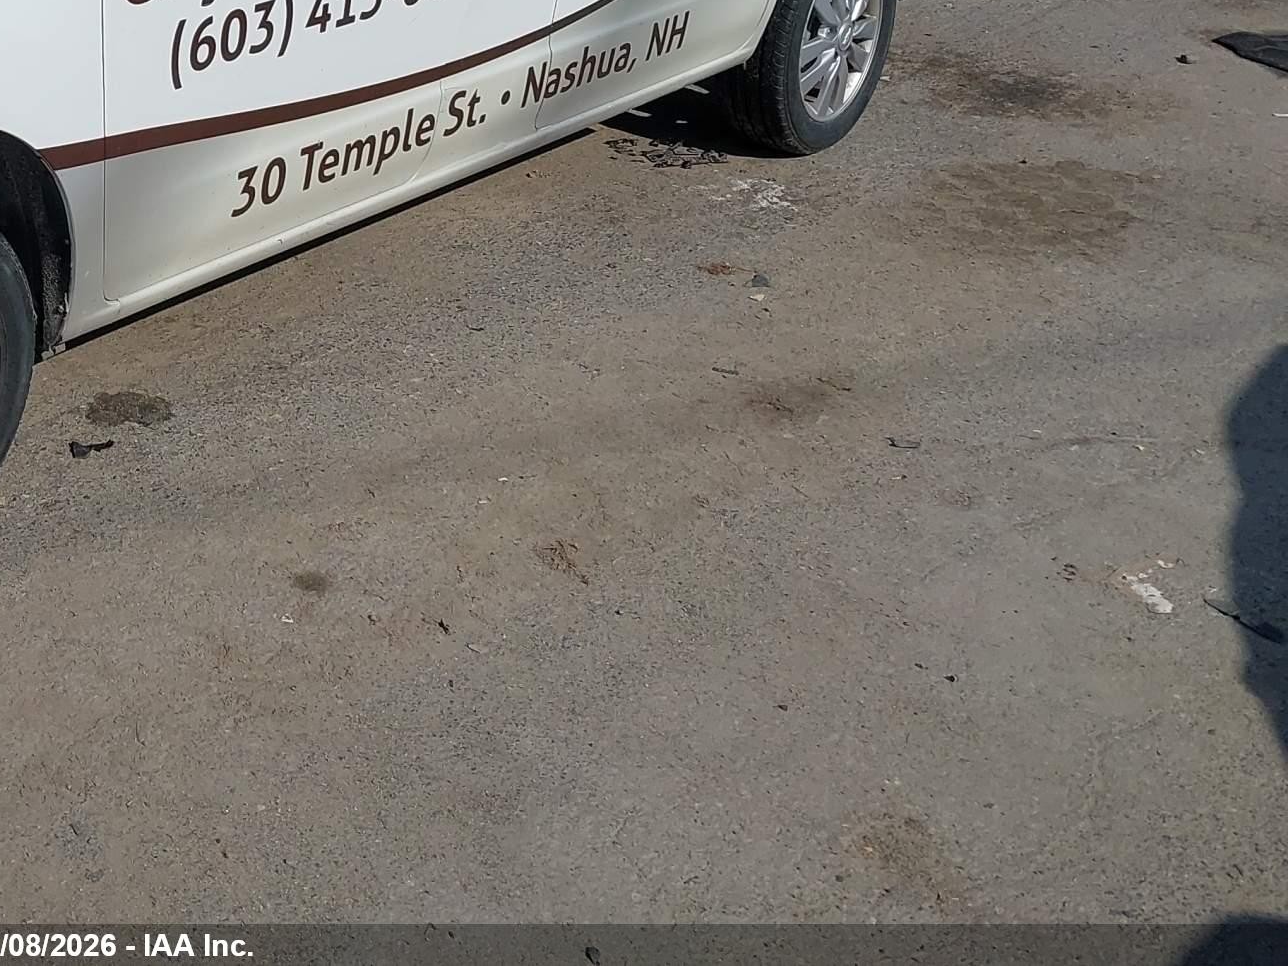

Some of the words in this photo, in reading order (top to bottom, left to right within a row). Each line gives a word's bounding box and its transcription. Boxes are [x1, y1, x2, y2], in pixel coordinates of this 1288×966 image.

[231, 157, 287, 217] 30
[299, 108, 436, 191] Temple
[443, 90, 486, 137] St.
[520, 42, 637, 109] Nashua,
[645, 11, 690, 64] NH
